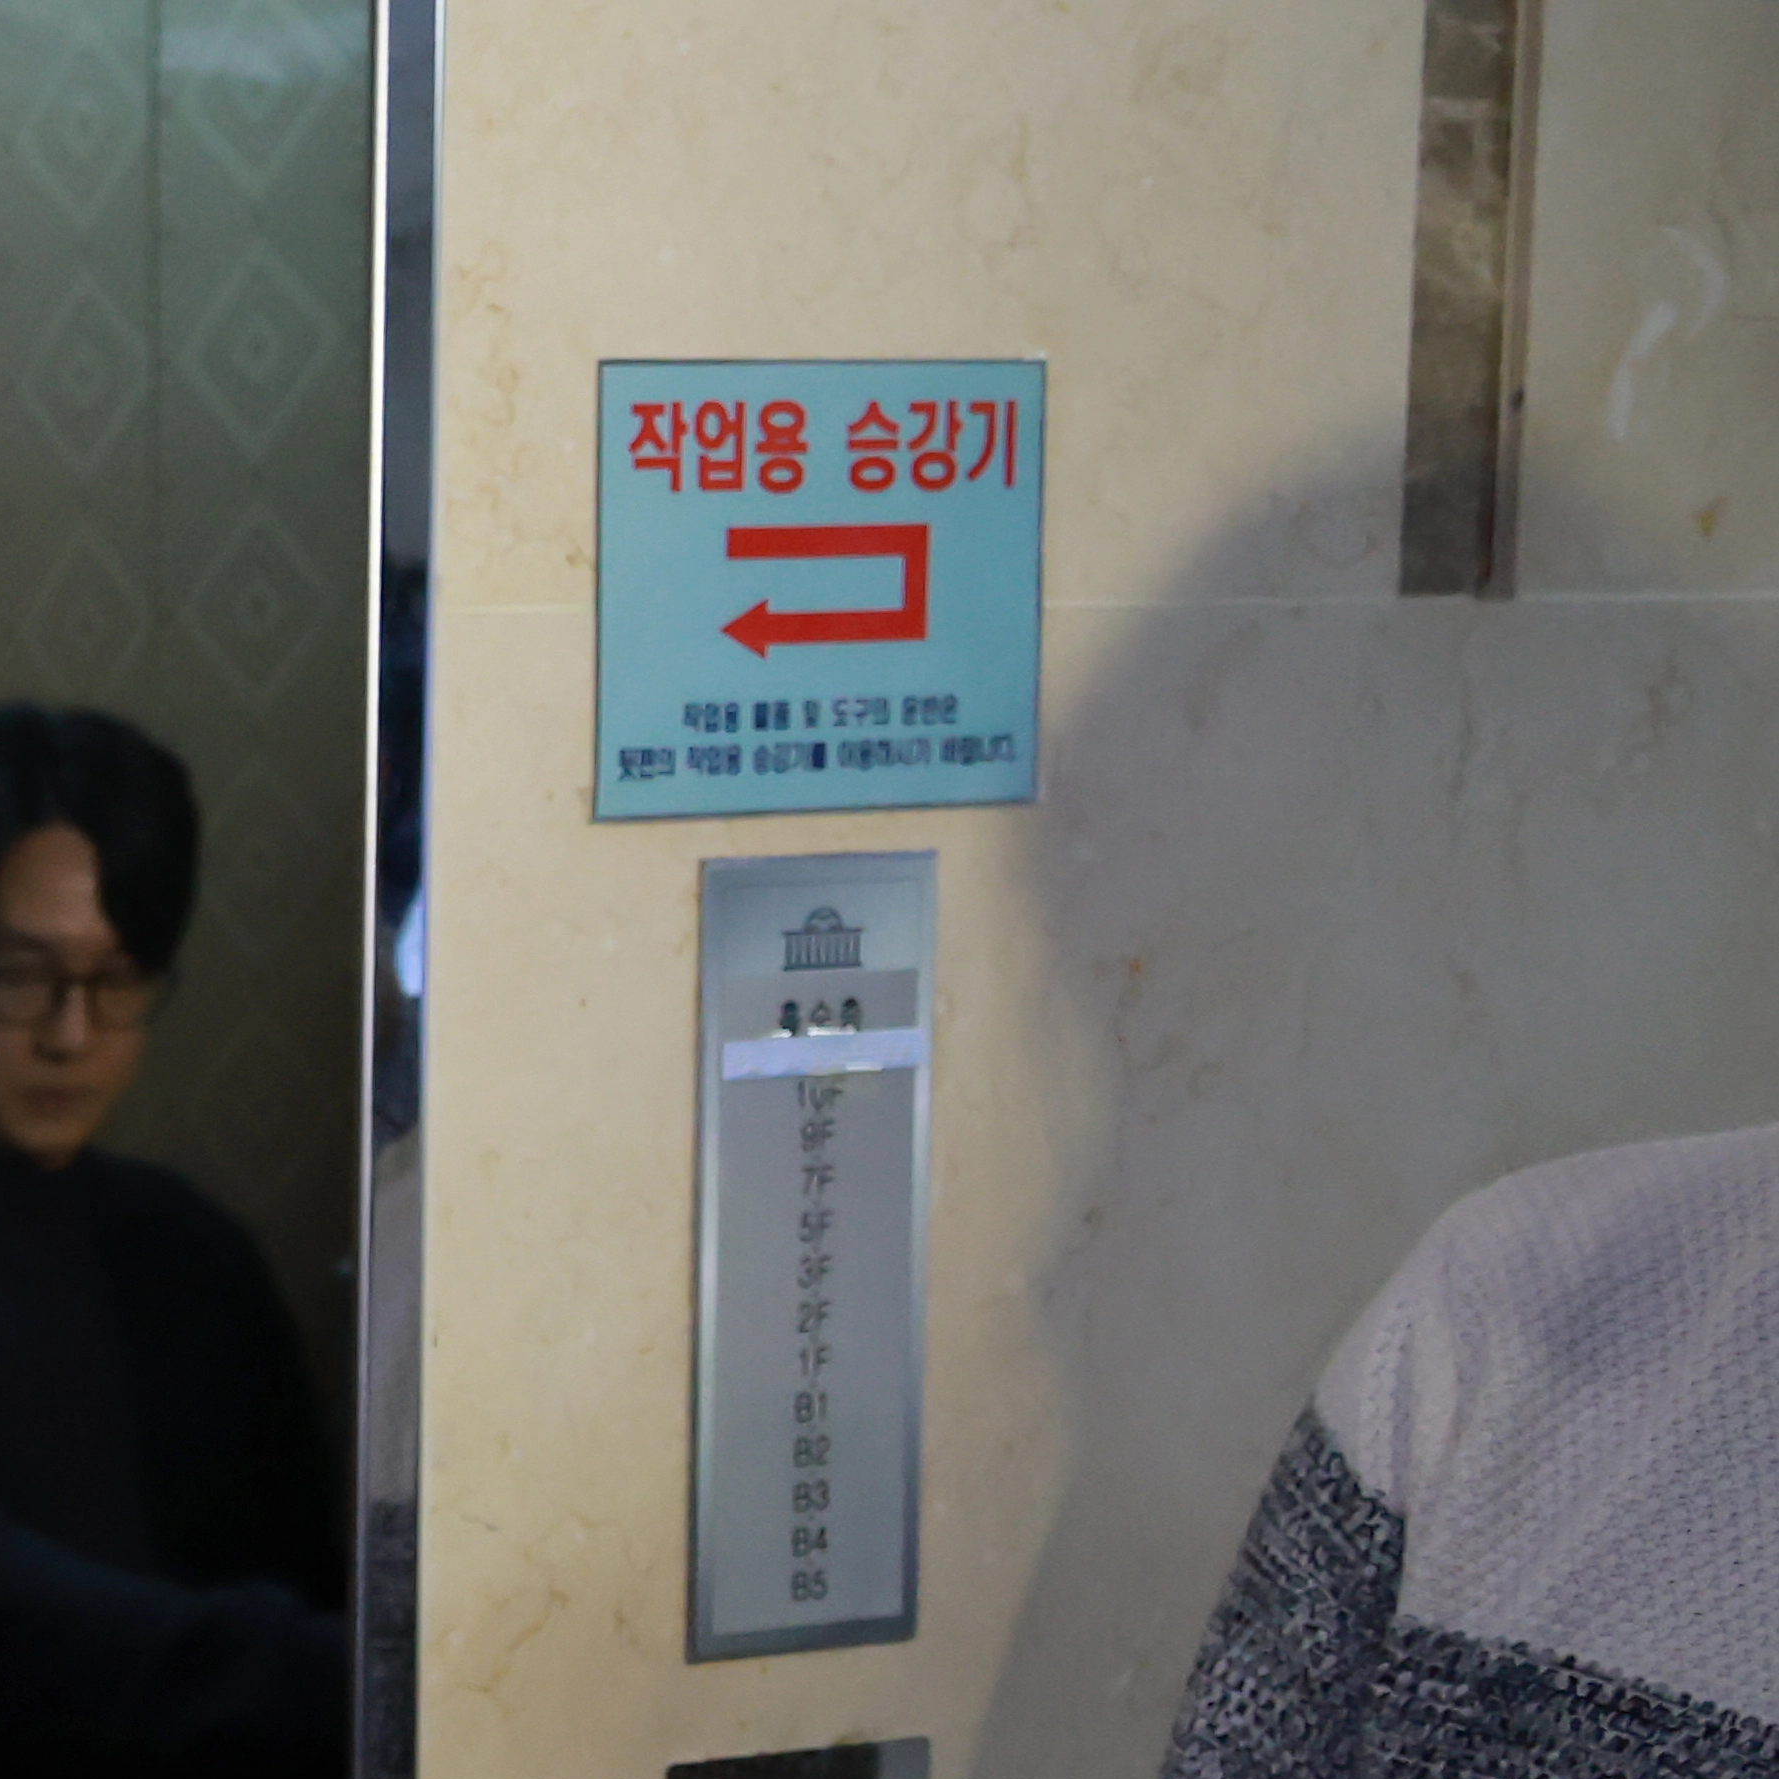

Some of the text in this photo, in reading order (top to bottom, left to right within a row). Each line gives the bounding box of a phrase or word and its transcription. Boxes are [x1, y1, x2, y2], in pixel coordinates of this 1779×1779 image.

[629, 400, 1018, 493] 작업용 승강기
[801, 1163, 835, 1195] 7F
[799, 1211, 833, 1243] 5F
[798, 1255, 832, 1289] 3F
[797, 1301, 831, 1335] 2F
[799, 1346, 830, 1377] 1F
[794, 1392, 828, 1424] B1
[793, 1435, 831, 1468] B2
[792, 1479, 831, 1513] B3
[791, 1526, 828, 1558] B4
[790, 1569, 829, 1602] B5
